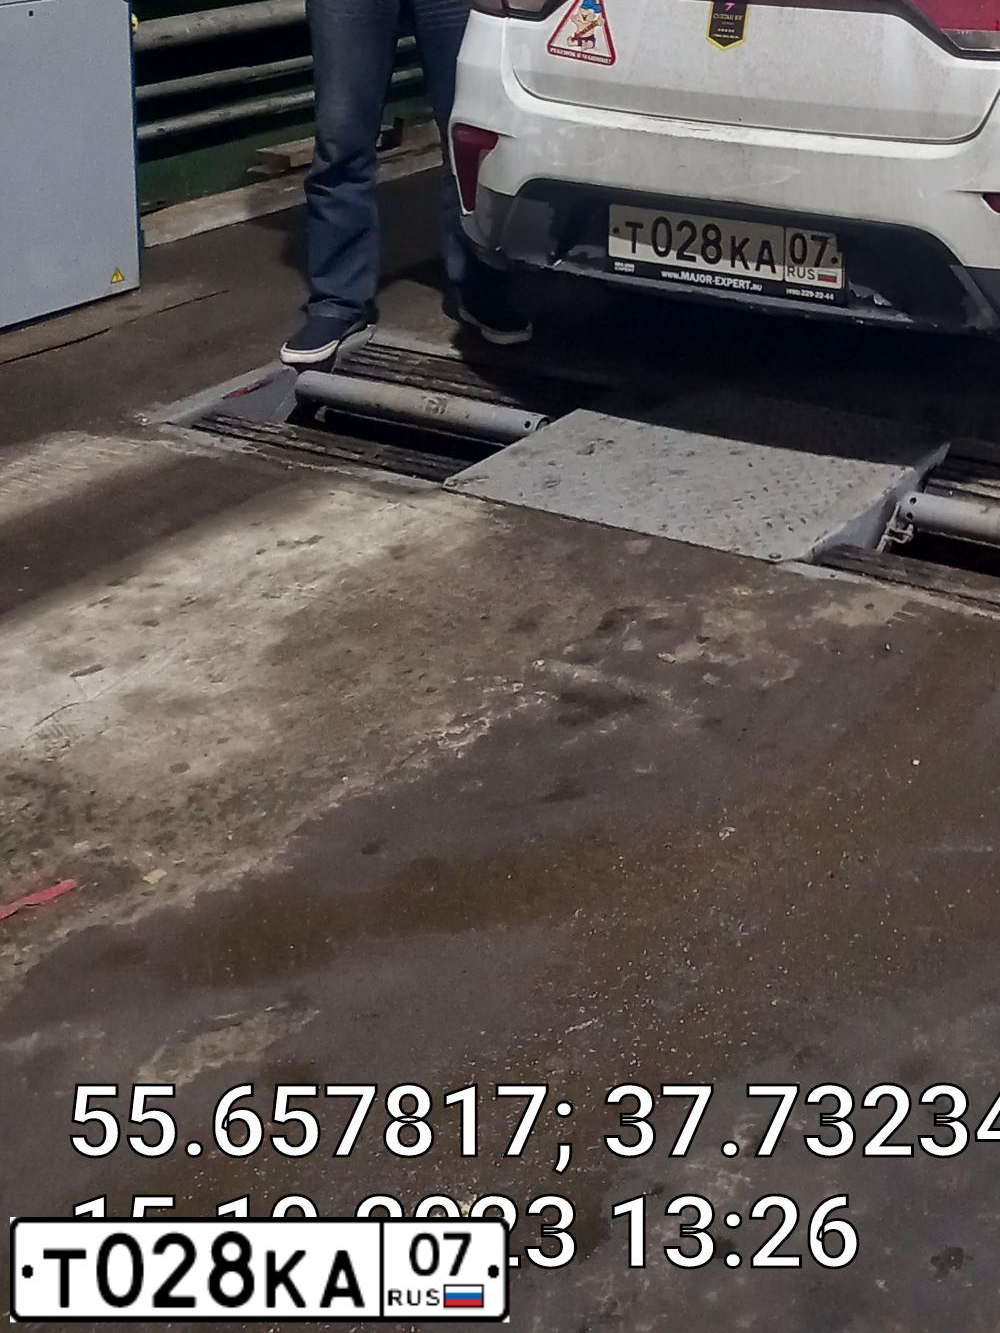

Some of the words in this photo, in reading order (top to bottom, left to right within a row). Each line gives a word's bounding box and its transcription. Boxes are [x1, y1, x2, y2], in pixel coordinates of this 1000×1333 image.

[625, 216, 777, 274] Т028КА
[789, 233, 830, 267] 07
[787, 268, 816, 280] RUS
